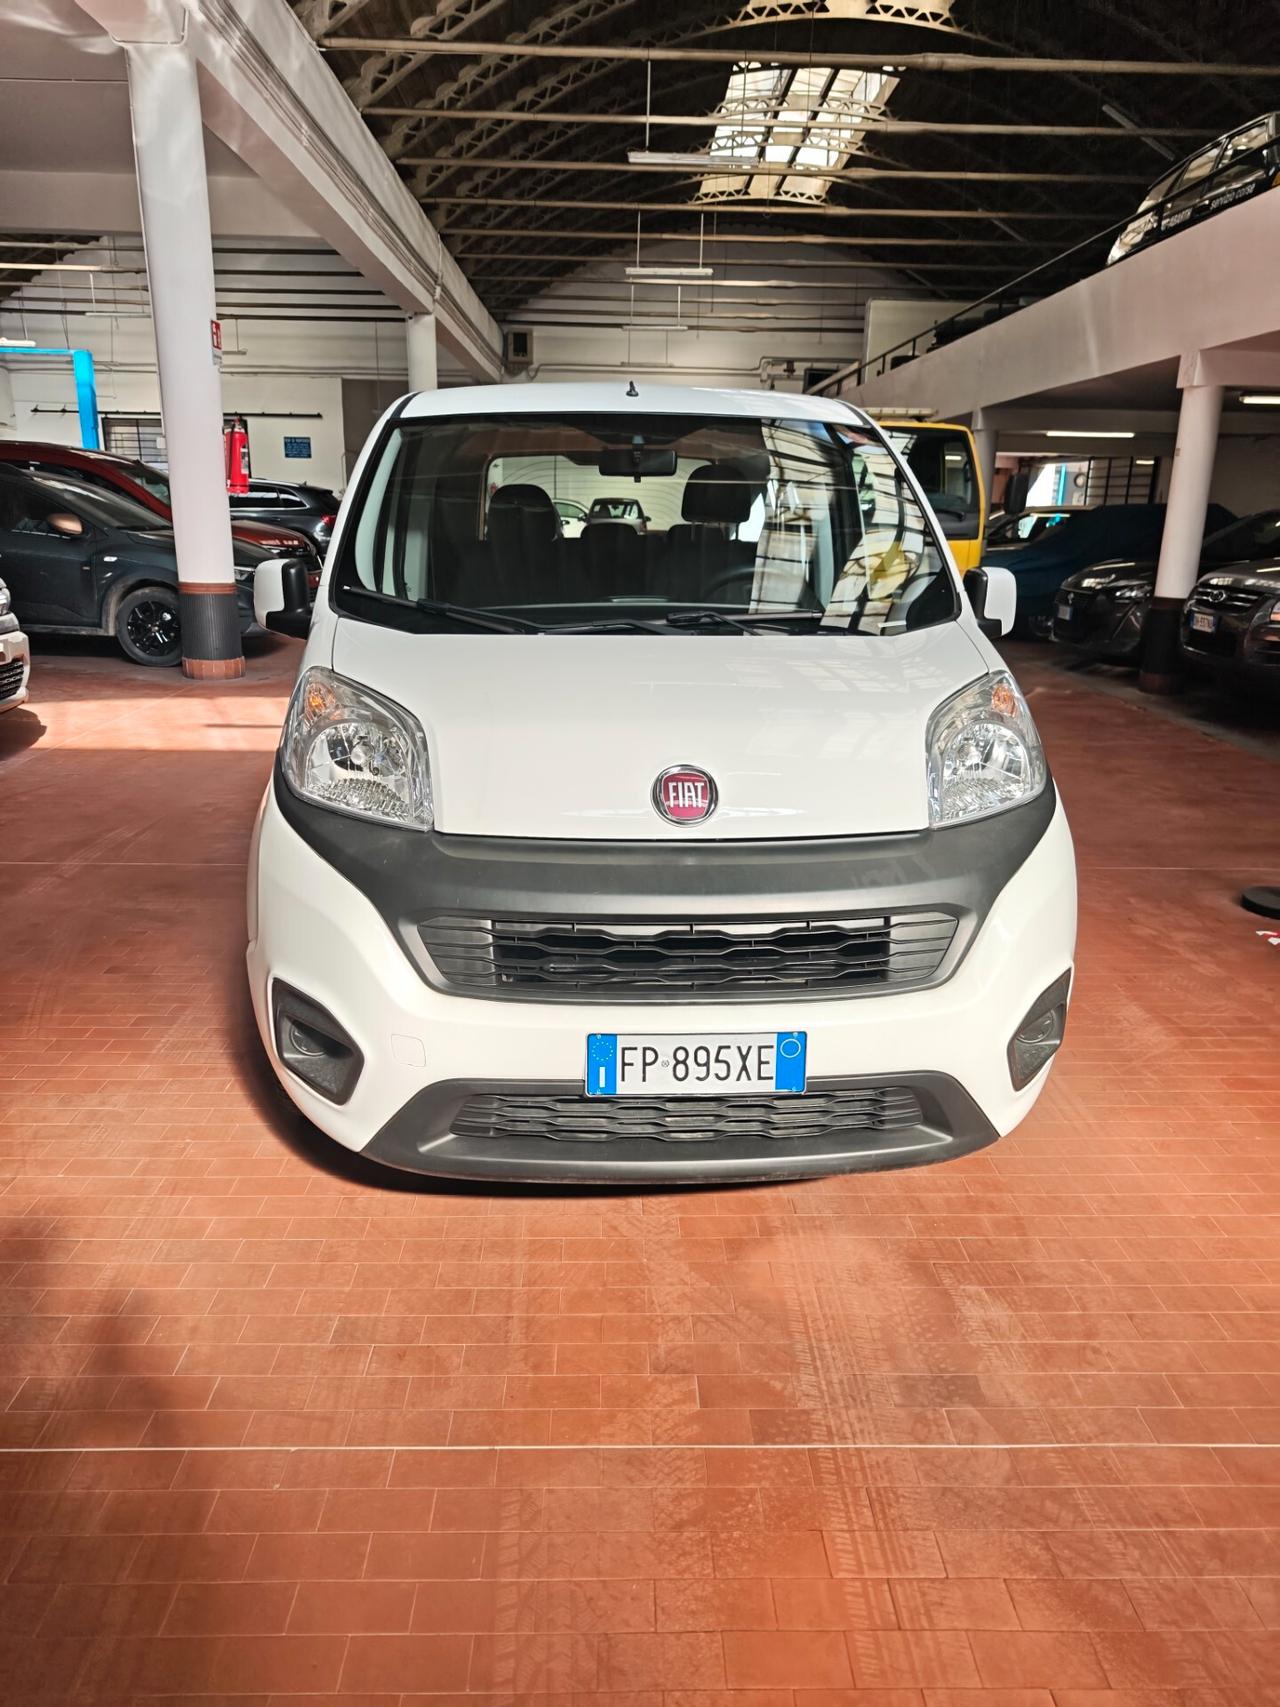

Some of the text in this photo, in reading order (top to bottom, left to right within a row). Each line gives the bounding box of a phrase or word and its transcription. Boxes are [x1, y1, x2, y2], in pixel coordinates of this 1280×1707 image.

[668, 782, 705, 808] FIAT
[620, 1044, 775, 1083] FP 895XE
